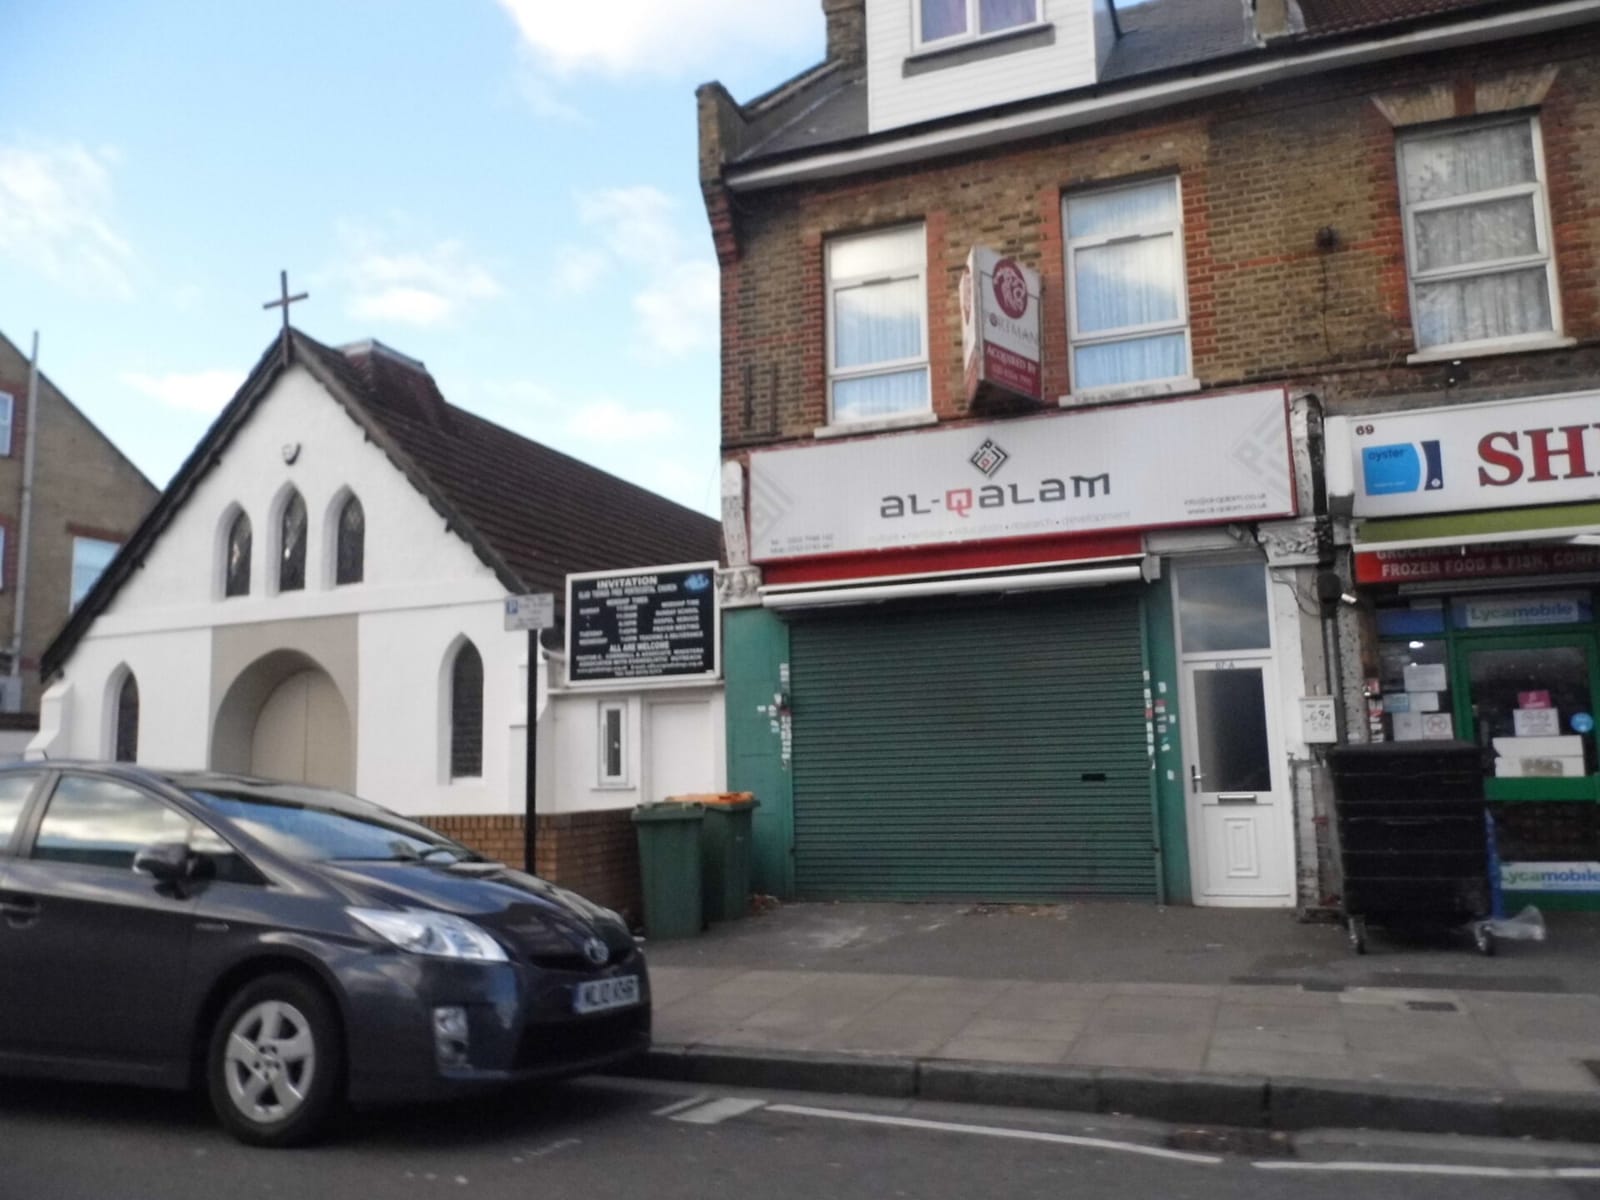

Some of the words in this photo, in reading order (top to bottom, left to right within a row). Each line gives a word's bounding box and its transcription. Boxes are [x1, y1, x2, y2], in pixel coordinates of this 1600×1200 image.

[1356, 423, 1374, 435] 69
[1367, 447, 1406, 461] oyster
[1477, 423, 1600, 487] SH
[1382, 559, 1441, 577] FROZEN
[1445, 557, 1487, 573] FOOD
[596, 576, 658, 588] INVITATION
[1471, 603, 1572, 621] Lycamobile
[609, 643, 621, 652] ALL
[623, 643, 635, 651] ARE
[637, 641, 669, 651] WELCOME
